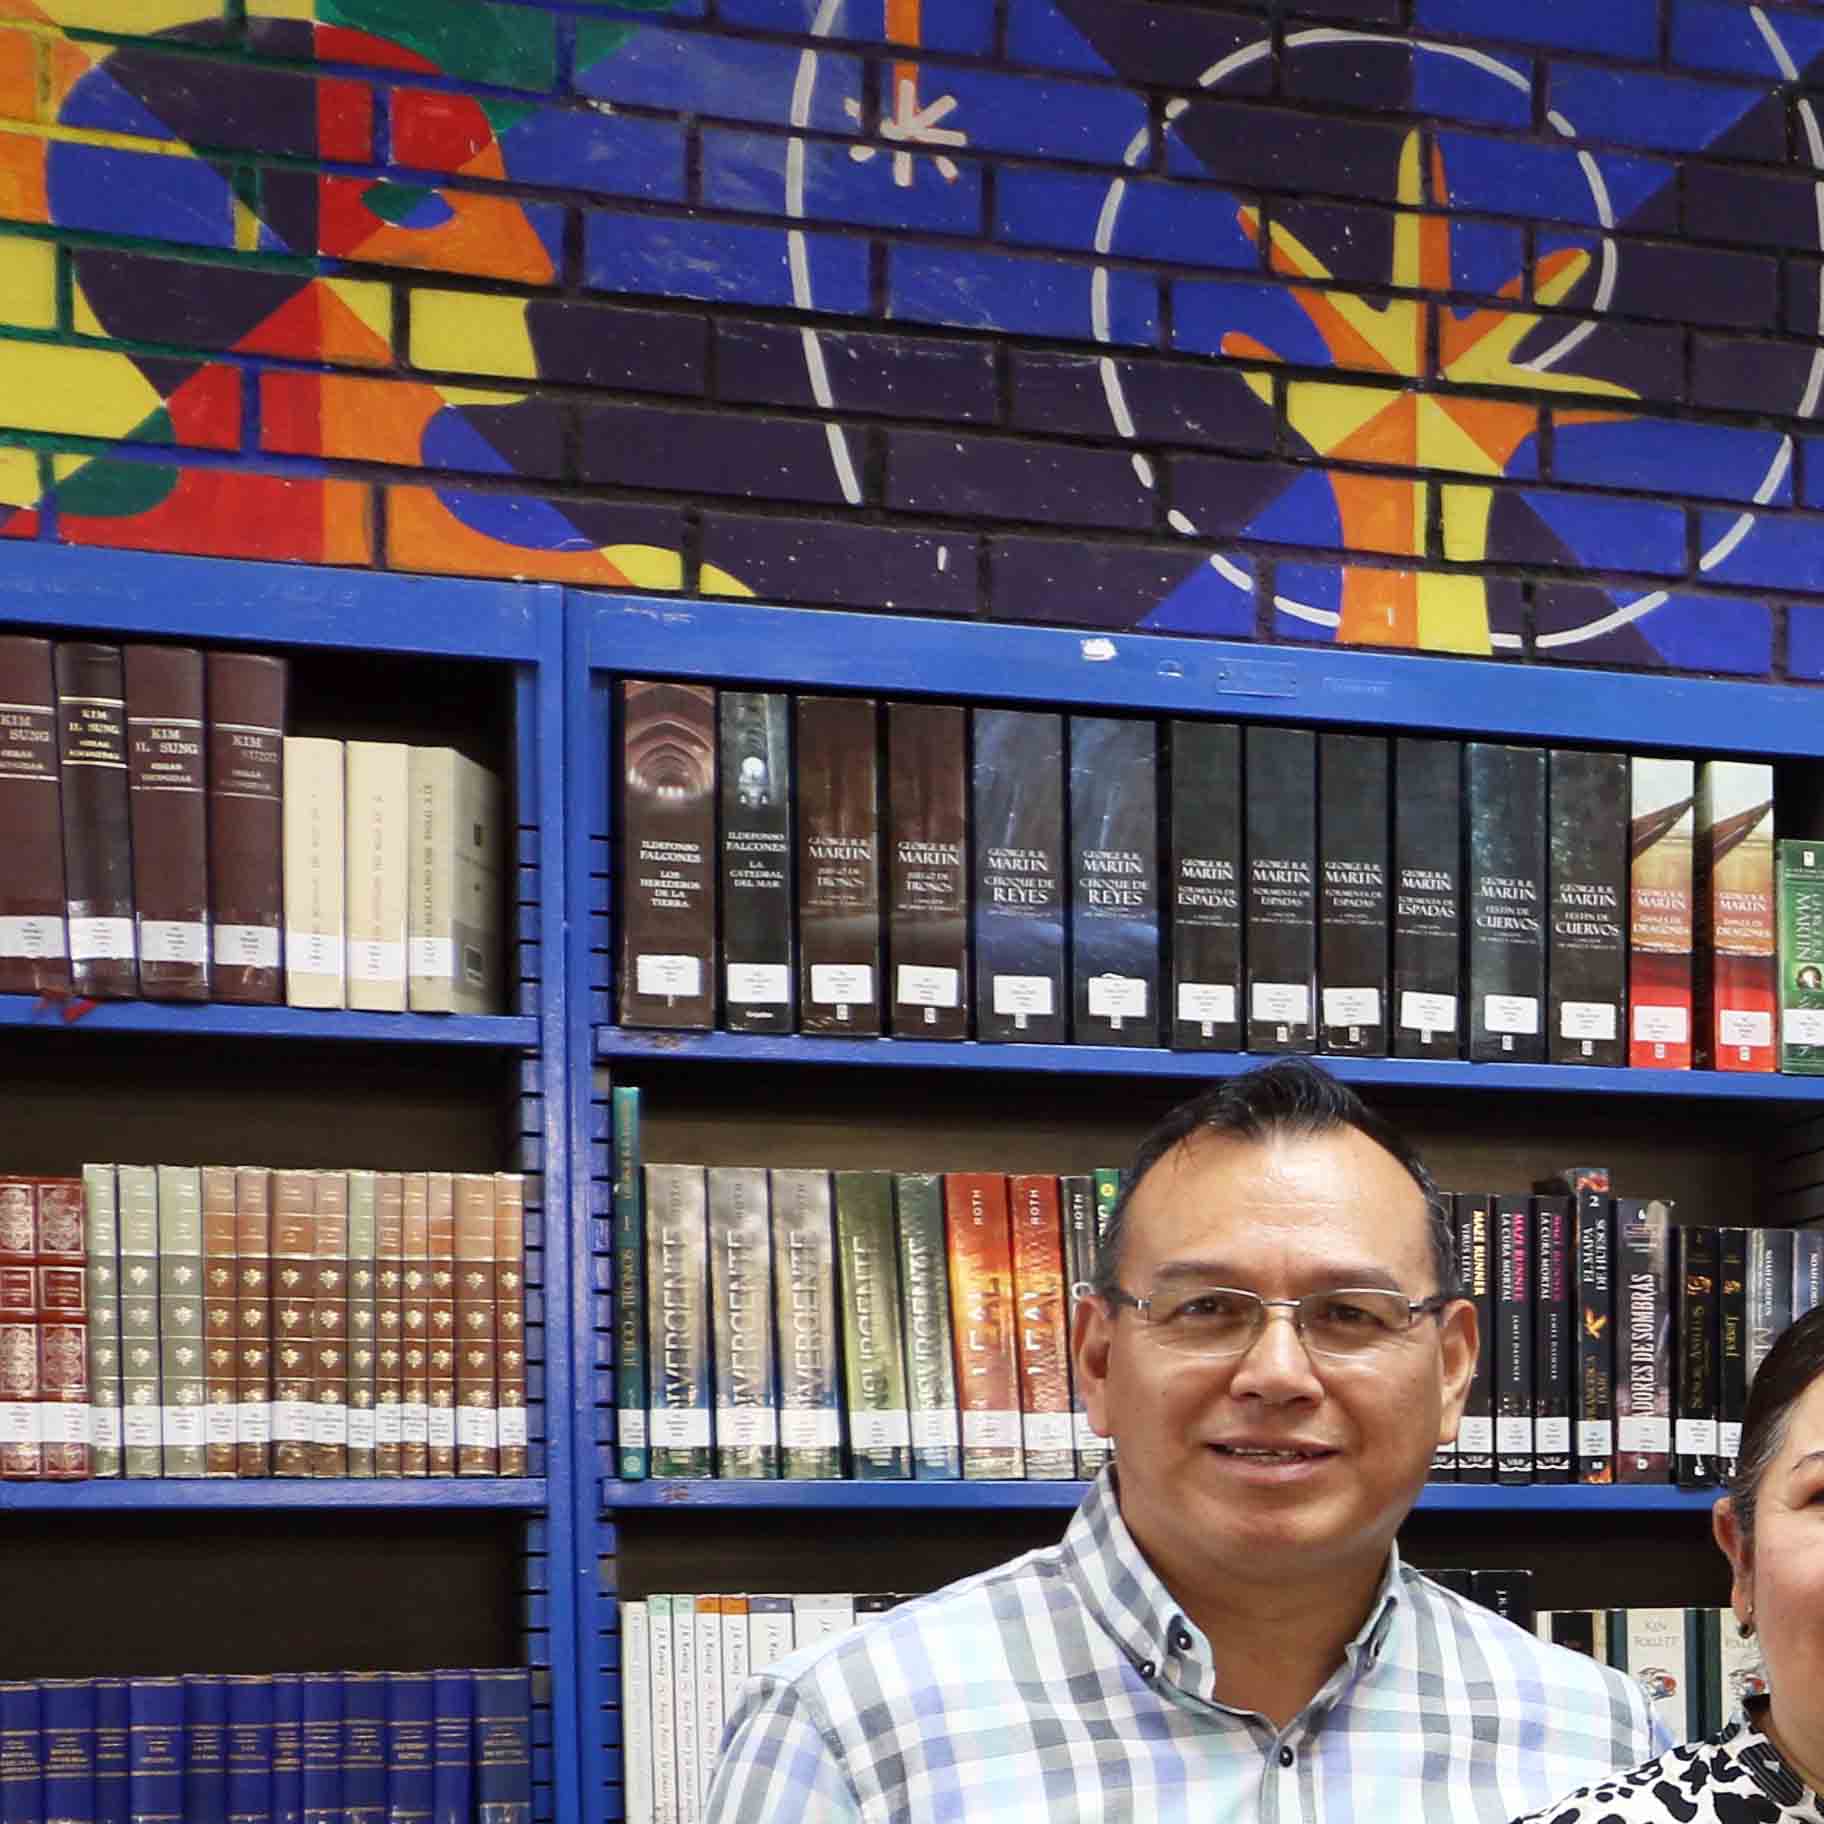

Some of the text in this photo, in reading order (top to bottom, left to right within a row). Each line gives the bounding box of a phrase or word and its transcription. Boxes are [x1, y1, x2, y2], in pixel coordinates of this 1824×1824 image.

[81, 709, 109, 720] KIM
[9, 729, 50, 742] SUNG
[88, 723, 121, 735] SUNG
[151, 728, 181, 739] KIM
[136, 741, 199, 755] IL SUNG
[232, 734, 264, 748] KIM
[726, 842, 788, 852] FALCONES
[809, 846, 872, 860] MARTIN
[640, 850, 702, 863] FALCONES
[898, 851, 960, 865] MARTIN
[988, 857, 1049, 871] MARTIN
[1083, 859, 1143, 873] MARTIN
[730, 868, 784, 880] CATEDRAL
[1181, 867, 1234, 880] MARTIN
[1252, 869, 1312, 884] MARTIN
[1325, 871, 1383, 885] MARTIN
[640, 878, 702, 890] HEREDEROS
[734, 879, 780, 889] DEL MAR
[1401, 877, 1452, 891] MARTIN
[653, 889, 686, 899] DE LA
[993, 887, 1049, 904] REYES
[1088, 888, 1144, 905] REYES
[1178, 893, 1238, 908] ESPADAS
[1479, 886, 1537, 902] MARTIN
[1559, 891, 1617, 907] MARTIN
[1398, 904, 1456, 918] ESPADAS
[1476, 915, 1540, 931] CUERVOS
[1555, 920, 1620, 936] CUERVOS
[1796, 892, 1811, 961] MARTIN
[972, 1188, 985, 1226] ROTH
[1028, 1188, 1041, 1226] ROTH
[1589, 1196, 1600, 1207] 2
[1073, 1193, 1085, 1231] ROTH
[1512, 1213, 1525, 1246] MAZE
[1460, 1223, 1473, 1259] VIRUS
[1473, 1210, 1487, 1297] MAZE RUNNER
[1582, 1228, 1595, 1283] EL MAPA
[1594, 1219, 1607, 1290] DE HUESOS
[1500, 1225, 1512, 1301] CURA MORTAL
[1540, 1225, 1551, 1300] CURA MORTAL
[1763, 1249, 1776, 1317] NOAH GORDON
[1630, 1273, 1657, 1362] DE SOMBRAS
